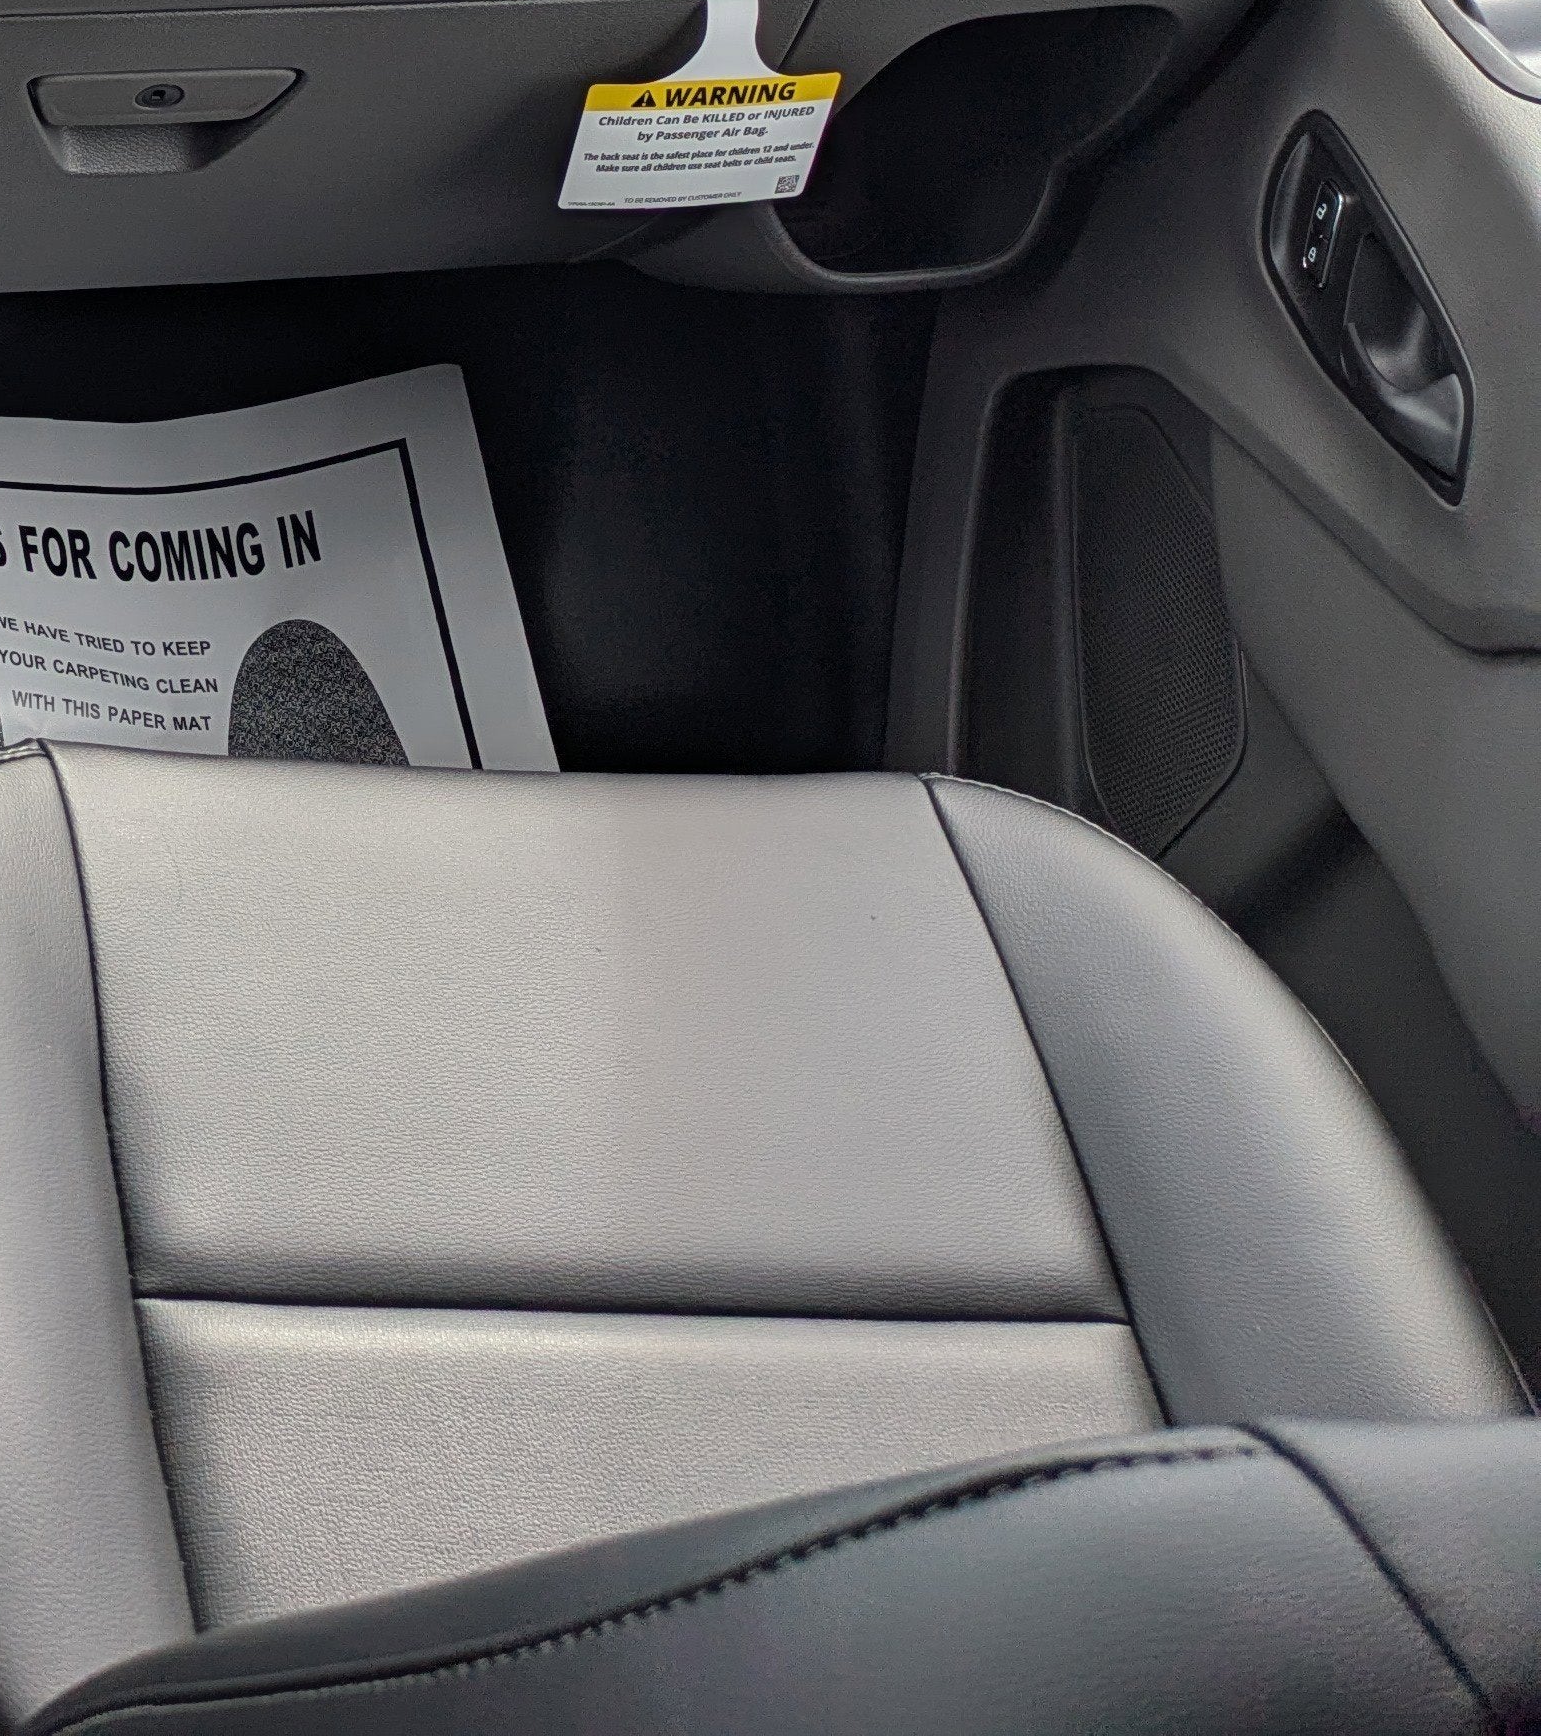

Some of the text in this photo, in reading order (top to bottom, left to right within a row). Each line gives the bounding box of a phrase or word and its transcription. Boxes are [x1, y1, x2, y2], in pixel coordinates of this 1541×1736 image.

[665, 81, 797, 107] WARNING
[598, 106, 815, 127] Children Can Be KILLED or INJURED
[637, 125, 768, 143] by Passenger Air Bag.
[583, 141, 815, 161] The back seat is the safest place for children 12 and under.
[596, 164, 619, 173] Make
[641, 163, 652, 172] all
[653, 162, 686, 172] children
[703, 160, 721, 170] seat
[722, 159, 742, 168] belts
[743, 158, 752, 166] or
[753, 156, 773, 165] child
[774, 154, 797, 164] seats.
[20, 524, 98, 581] FOR
[108, 521, 266, 584] COMING
[278, 510, 321, 568] IN
[24, 621, 70, 645] HAVE
[74, 630, 126, 655] TRIED
[130, 639, 157, 656] TO
[162, 639, 212, 658] KEEP
[52, 657, 151, 692] CARPETING
[155, 676, 220, 697] CLEAN
[11, 689, 213, 733] WITH THIS PAPER MAT
